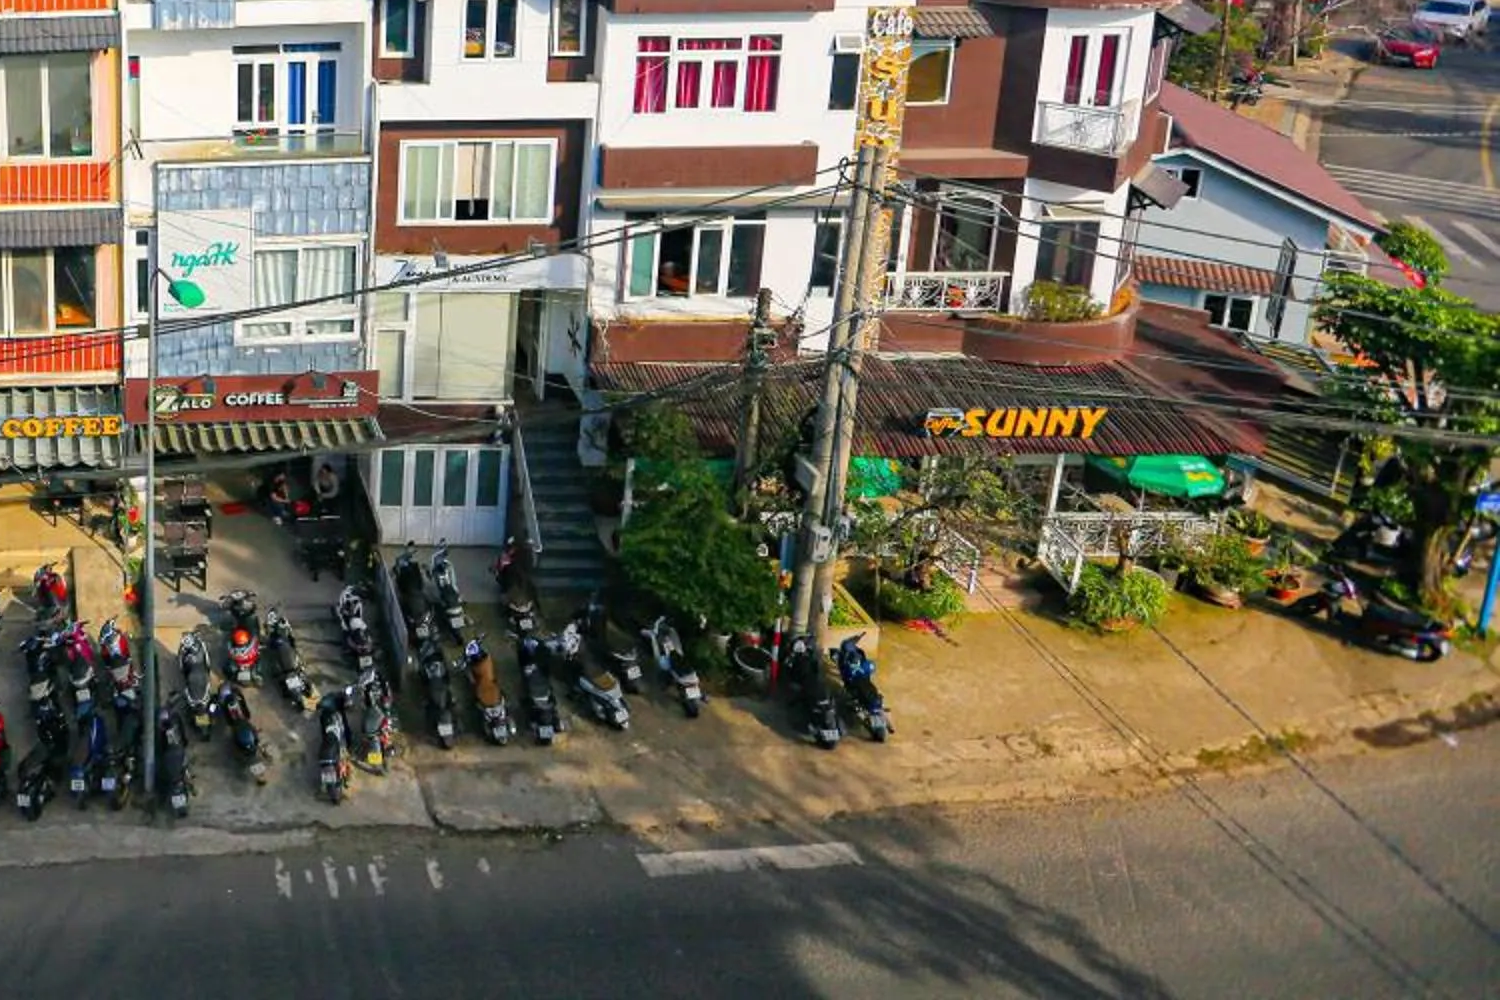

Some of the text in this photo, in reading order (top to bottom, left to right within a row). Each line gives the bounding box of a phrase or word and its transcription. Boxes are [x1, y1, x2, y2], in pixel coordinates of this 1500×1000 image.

[225, 391, 285, 406] COFFEE
[2, 416, 122, 438] COFFEE
[961, 407, 1109, 439] SUNNY
